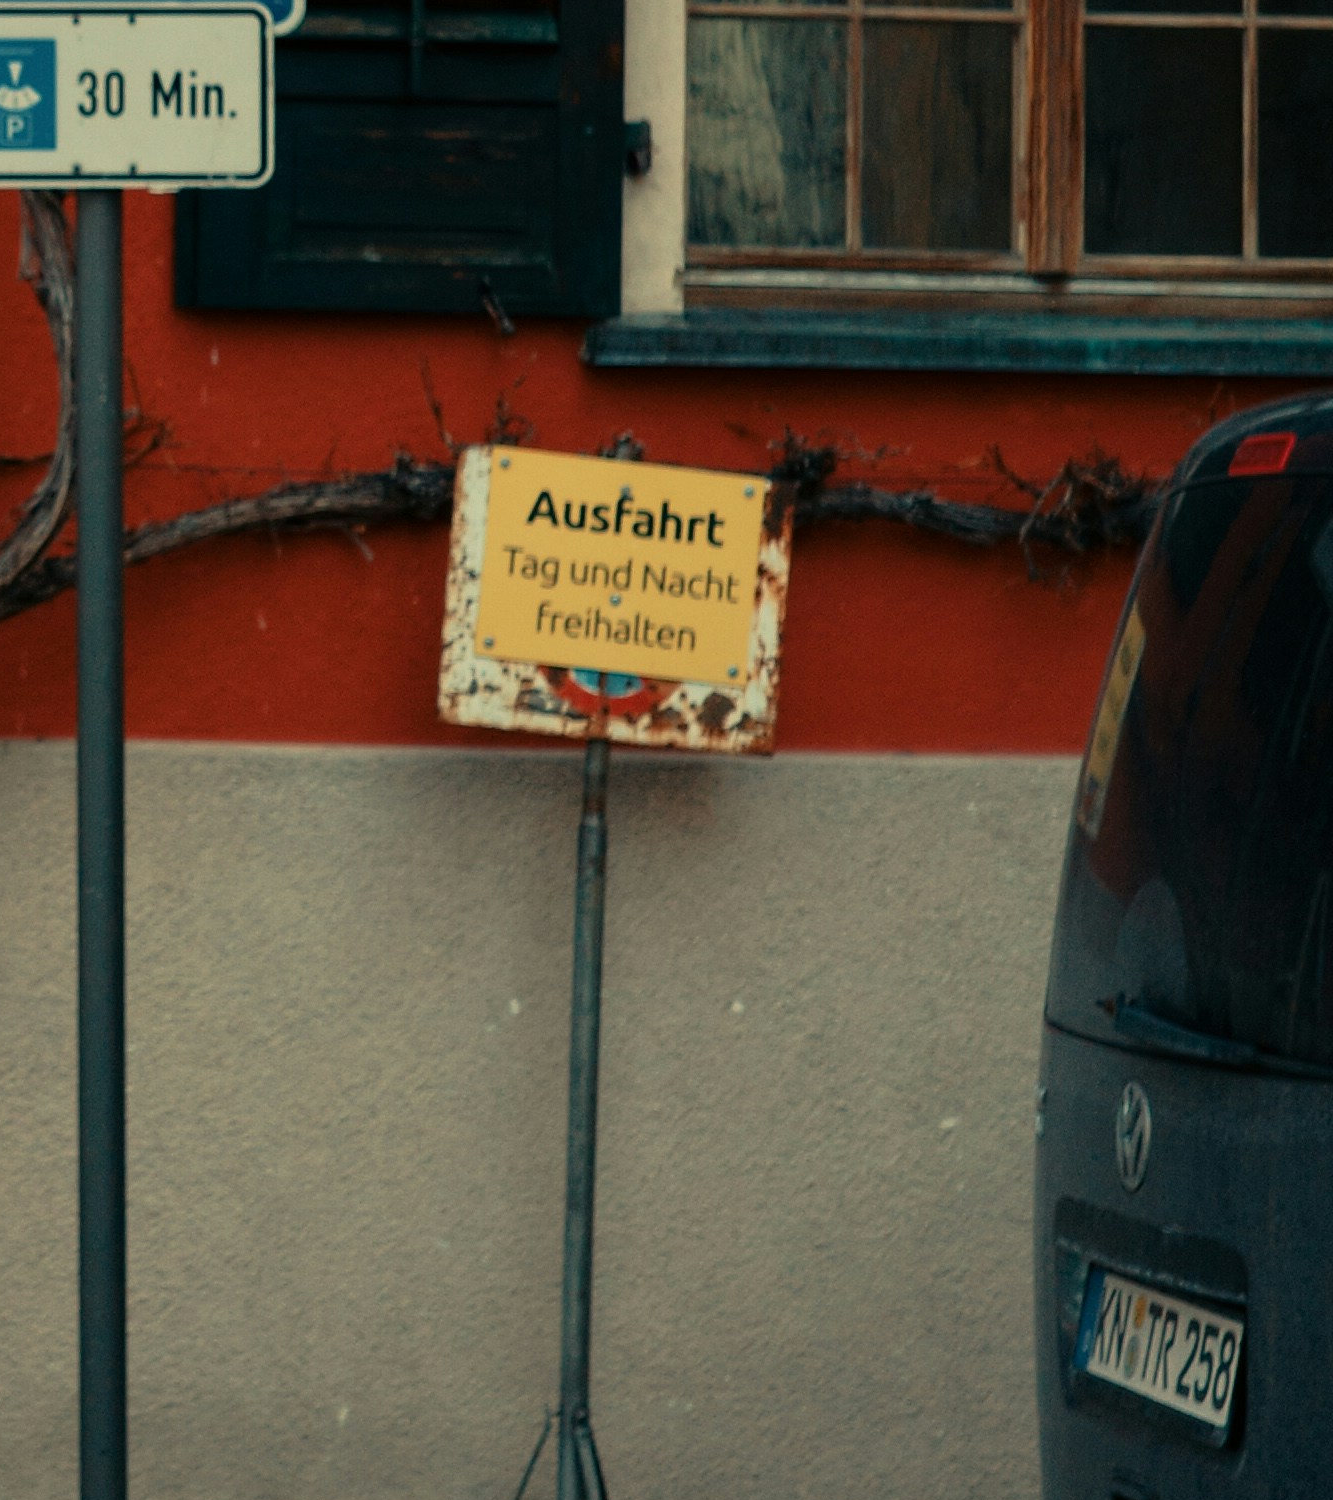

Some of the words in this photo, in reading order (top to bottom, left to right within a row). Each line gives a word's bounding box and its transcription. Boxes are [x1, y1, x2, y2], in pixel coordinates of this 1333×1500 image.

[77, 69, 126, 118] 30
[150, 68, 237, 119] Min.
[526, 490, 725, 547] Ausfahrt
[503, 545, 559, 586] Tag
[569, 560, 632, 591] und
[641, 564, 740, 604] Nacht
[535, 601, 697, 652] freihalten
[1093, 1289, 1132, 1368] KN
[1141, 1302, 1177, 1389] TR
[1177, 1317, 1236, 1411] 258
